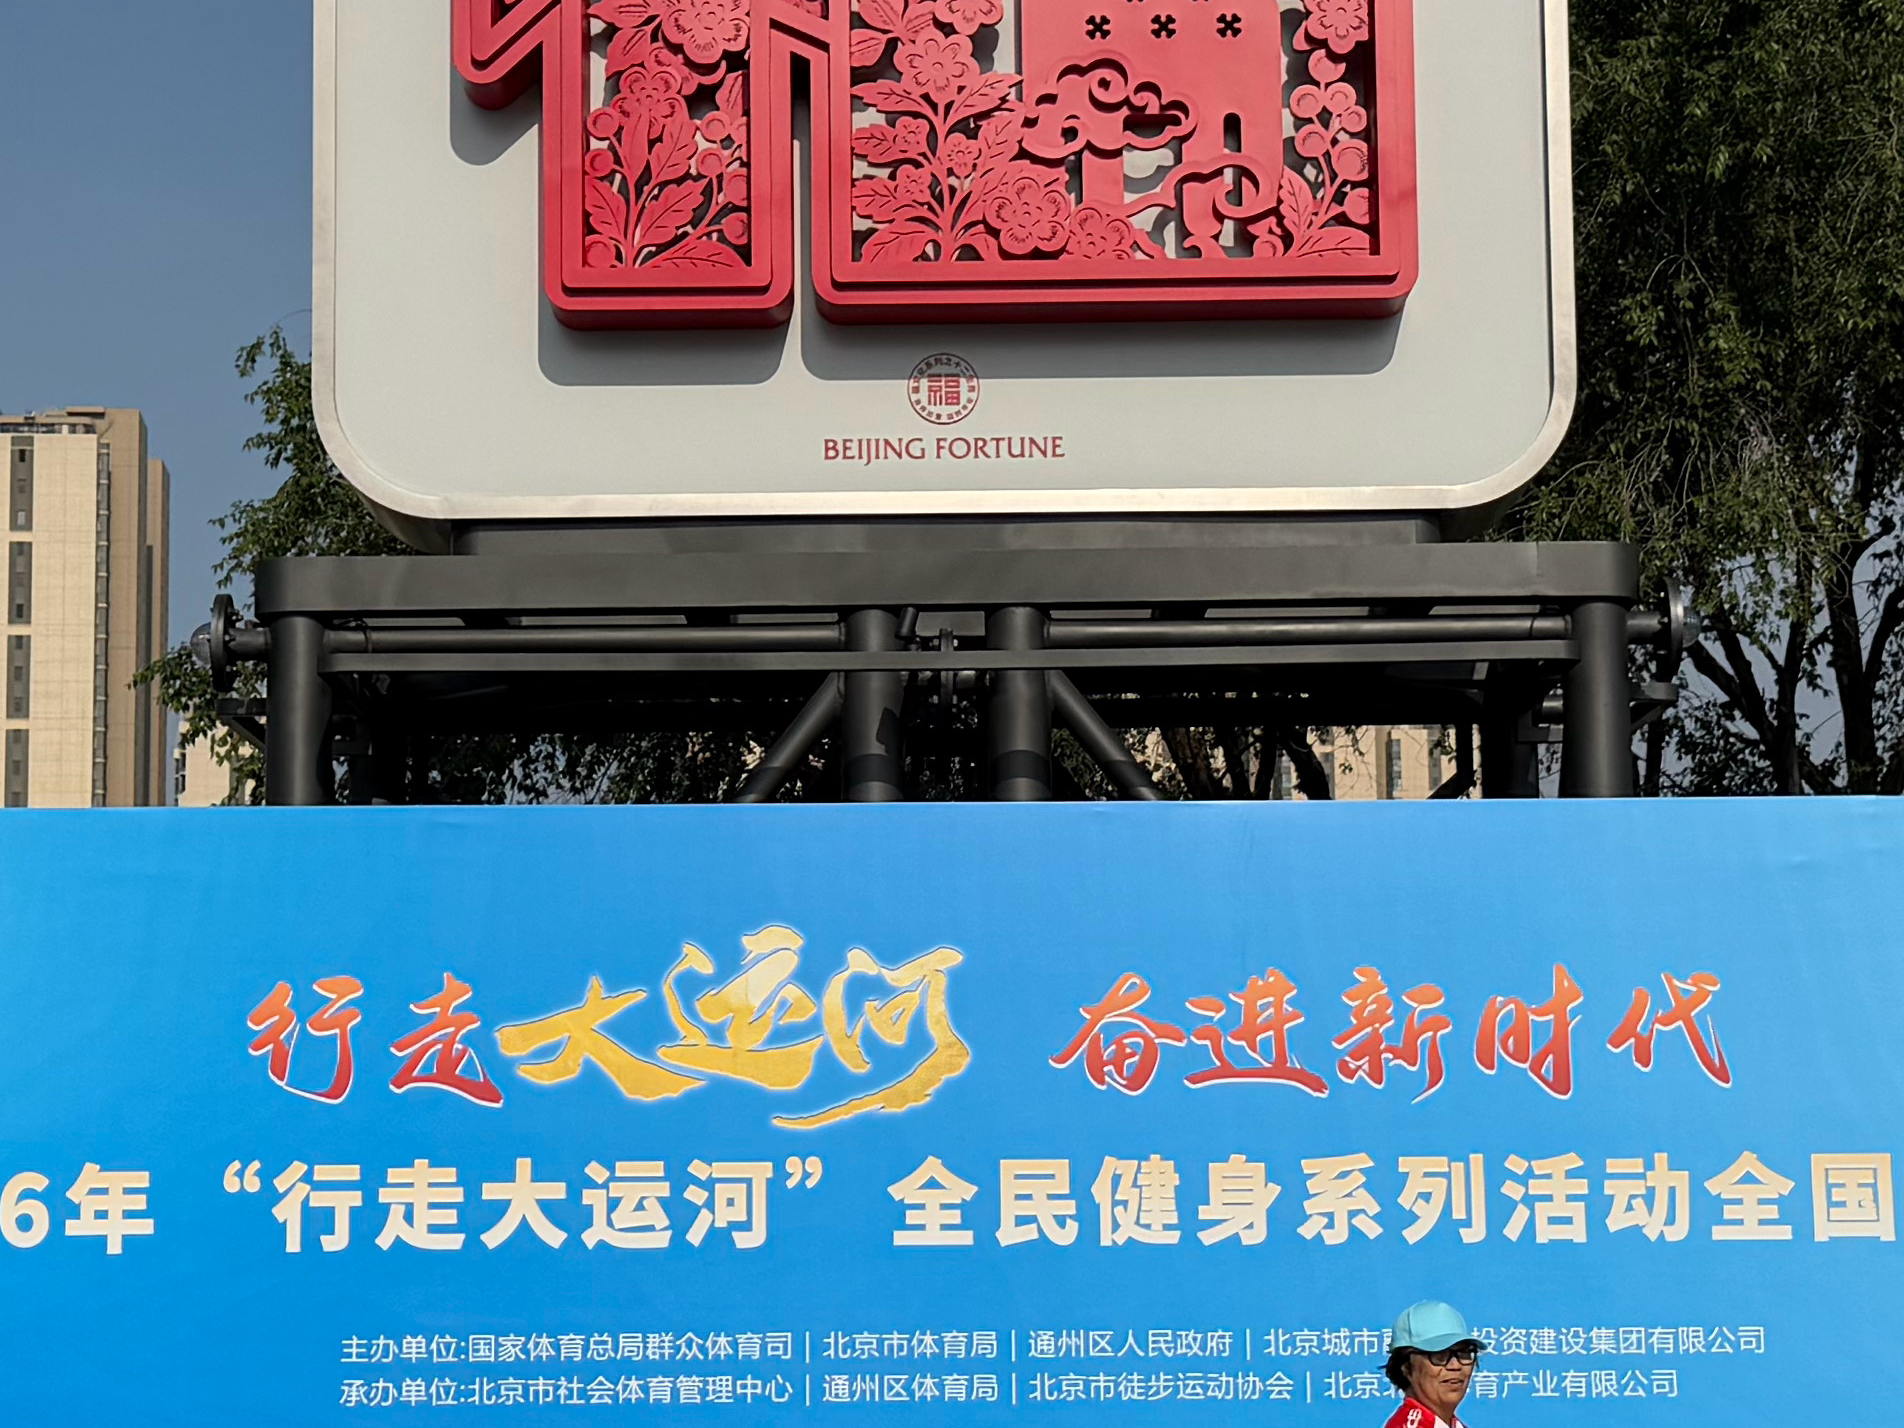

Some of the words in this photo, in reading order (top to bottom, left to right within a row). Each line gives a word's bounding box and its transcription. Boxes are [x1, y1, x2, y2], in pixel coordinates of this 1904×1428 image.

[824, 438, 926, 466] BEIJING
[936, 436, 1065, 460] FORTUNE
[246, 924, 974, 1130] 行走大运河
[1048, 962, 1734, 1104] 奋进新时代
[823, 1330, 997, 1359] 北京市体育局
[1029, 1329, 1233, 1358] 通州区人民政府
[1264, 1327, 1765, 1357] 北京城市投资建设集团有限公司
[823, 1373, 998, 1402] 通州区体育局
[1029, 1371, 1294, 1401] 北京市徒步运动协会
[1324, 1369, 1678, 1400] 北京育产业有限公司
